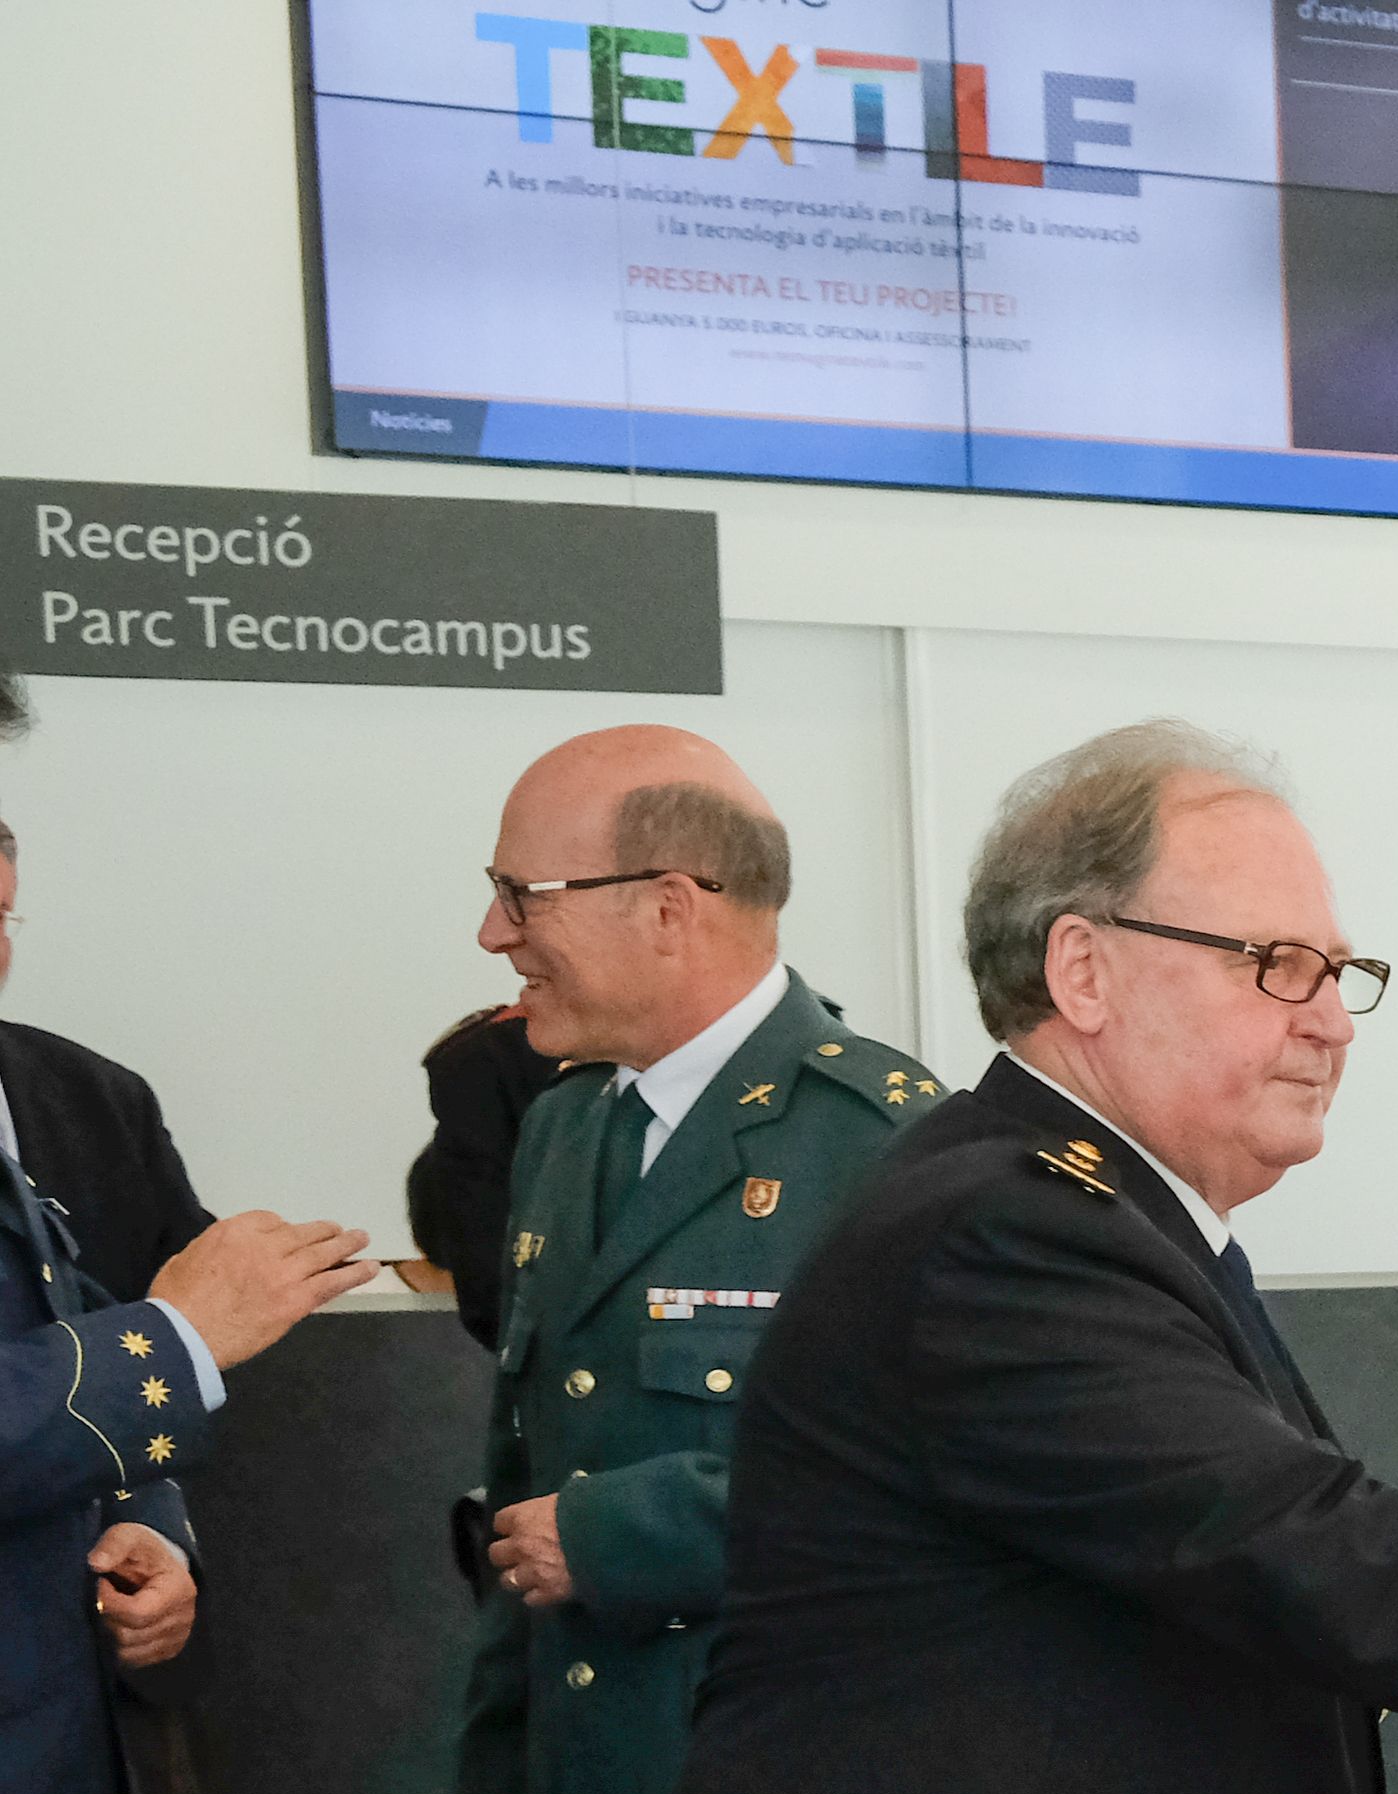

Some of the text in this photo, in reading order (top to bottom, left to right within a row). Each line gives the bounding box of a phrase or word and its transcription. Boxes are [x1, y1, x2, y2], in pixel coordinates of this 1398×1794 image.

[474, 12, 1141, 197] TEXTILE
[484, 168, 503, 189] A
[508, 170, 539, 192] les
[624, 180, 734, 210] iniciatives
[740, 195, 873, 223] empresarials
[878, 208, 905, 225] en
[989, 211, 1015, 233] de
[1019, 214, 1037, 236] la
[1042, 217, 1141, 245] innovació
[670, 214, 689, 237] la
[694, 219, 807, 250] tecnologia
[627, 264, 771, 298] PRESENTA
[778, 277, 811, 301] EL
[815, 279, 869, 306] TEU
[37, 505, 312, 576] Recepció
[43, 591, 591, 670] Parc Tecnocampus
